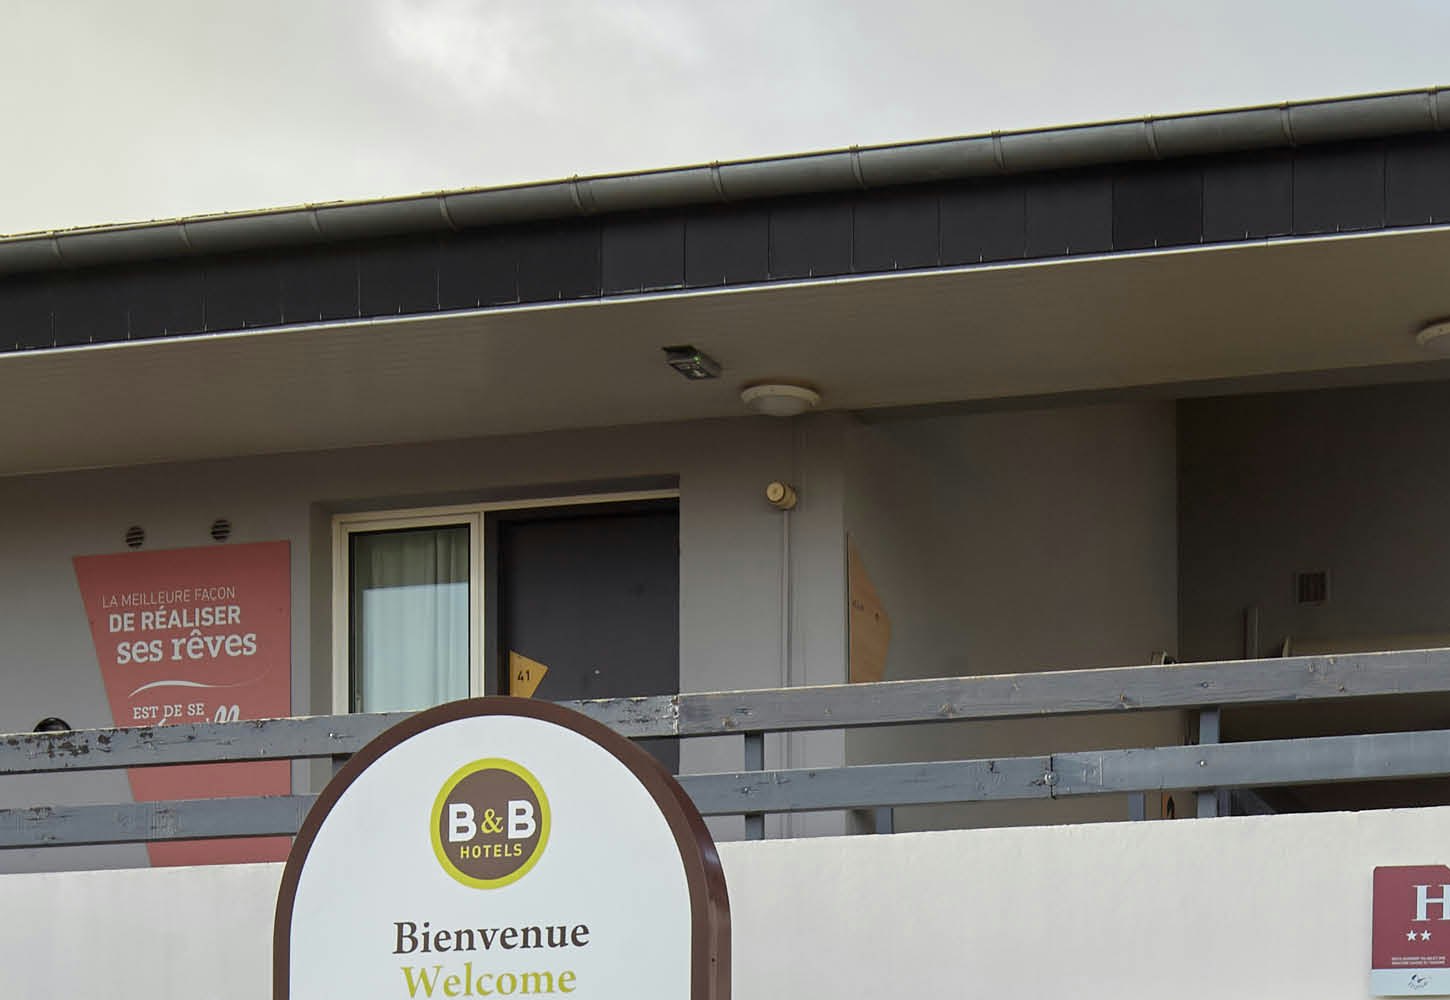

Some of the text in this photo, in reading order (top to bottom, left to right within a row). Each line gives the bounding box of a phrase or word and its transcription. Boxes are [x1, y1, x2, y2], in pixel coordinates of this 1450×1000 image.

[102, 594, 118, 608] LA
[121, 589, 190, 607] MEILLEURE
[109, 605, 241, 632] DE RÉALISER
[117, 629, 257, 665] ses rêves
[517, 669, 530, 681] 41
[133, 705, 159, 719] EST
[164, 704, 182, 718] DE
[187, 703, 205, 716] SE
[460, 843, 522, 859] HOTELS
[393, 920, 590, 955] Bienvenue
[401, 962, 577, 998] Welcome
